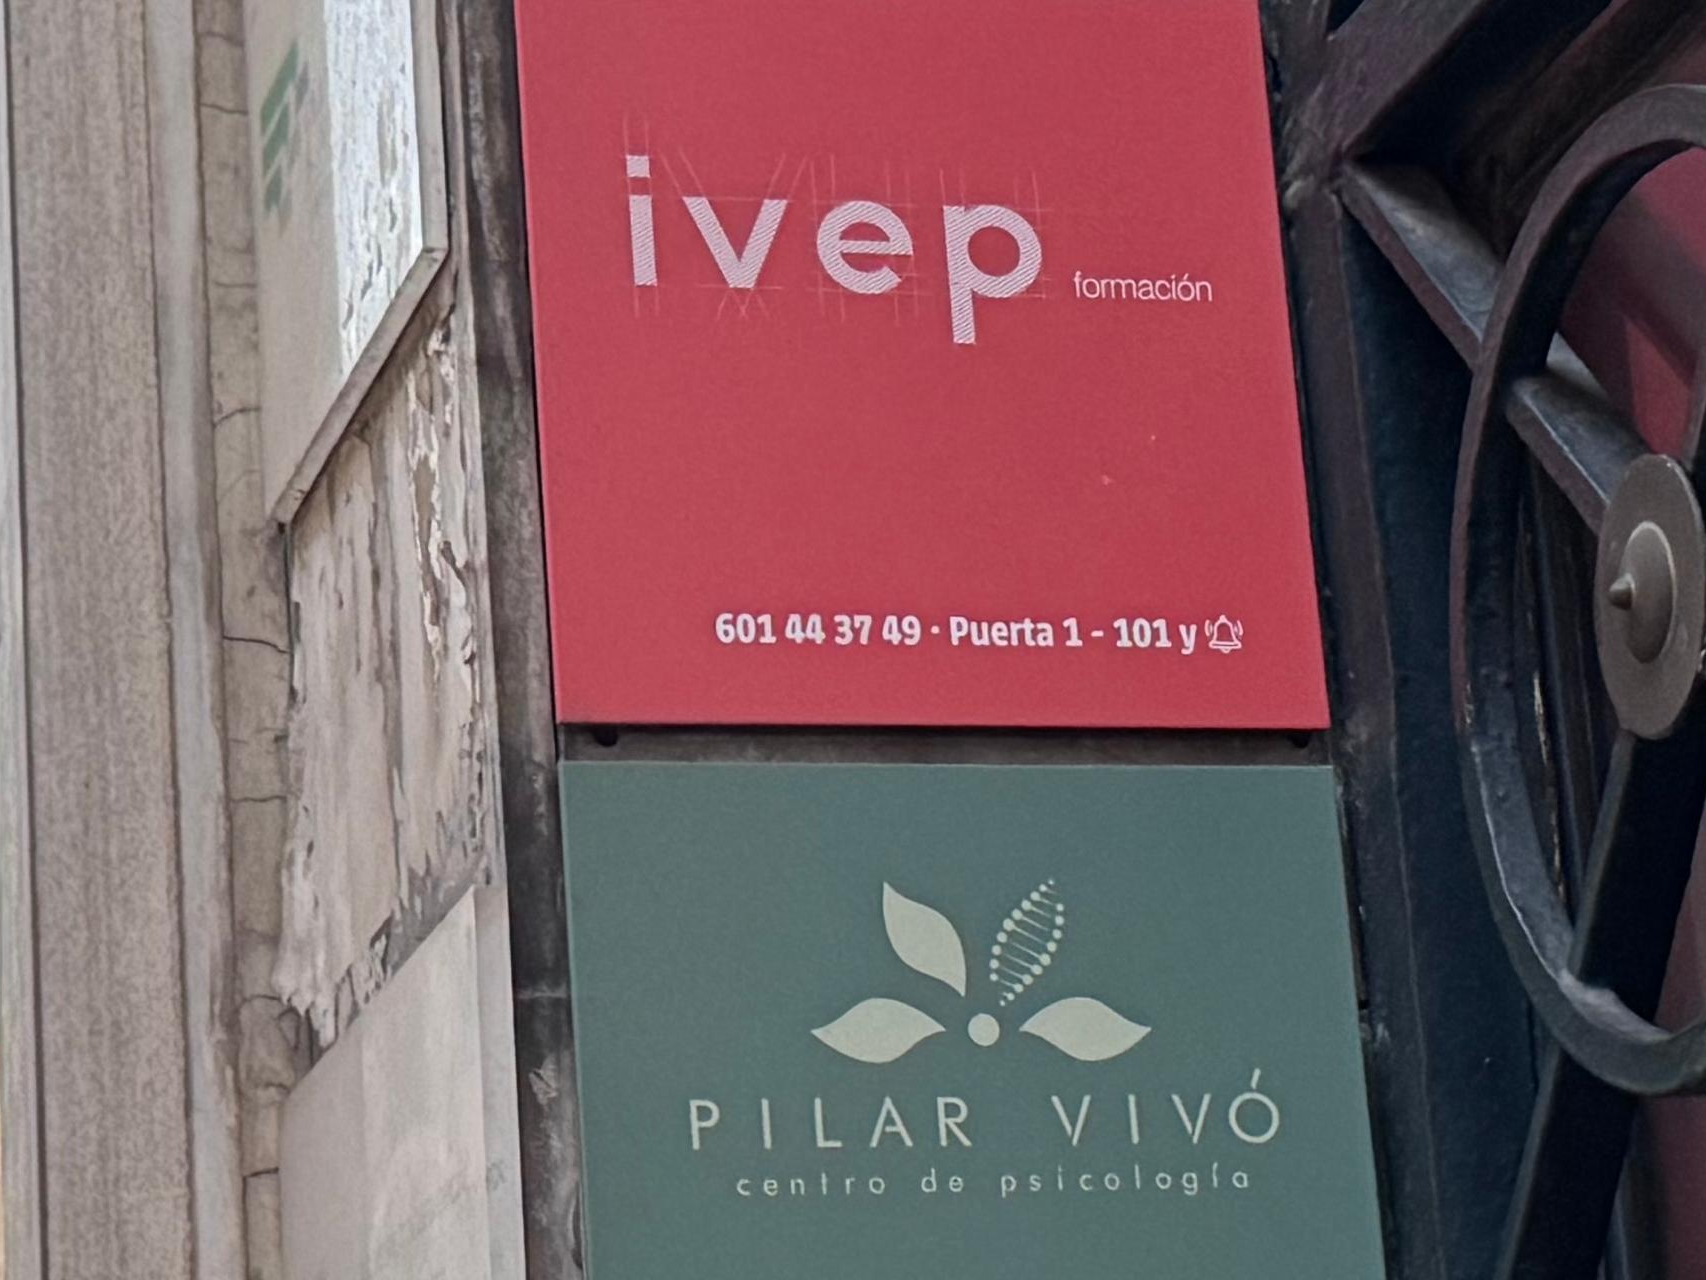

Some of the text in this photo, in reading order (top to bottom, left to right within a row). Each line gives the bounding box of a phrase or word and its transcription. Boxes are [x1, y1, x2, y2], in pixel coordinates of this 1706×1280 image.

[626, 155, 1042, 344] ivep
[1073, 270, 1213, 302] formación
[715, 613, 776, 645] 601
[785, 614, 824, 645] 44
[834, 615, 872, 646] 37
[882, 616, 921, 646] 49
[950, 616, 1054, 647] Puerta
[1063, 619, 1083, 647] 1
[1113, 617, 1172, 649] 101
[1179, 624, 1197, 655] y
[689, 1068, 1280, 1151] PILAR VIVÓ
[736, 1161, 1249, 1198] centro de psicología
